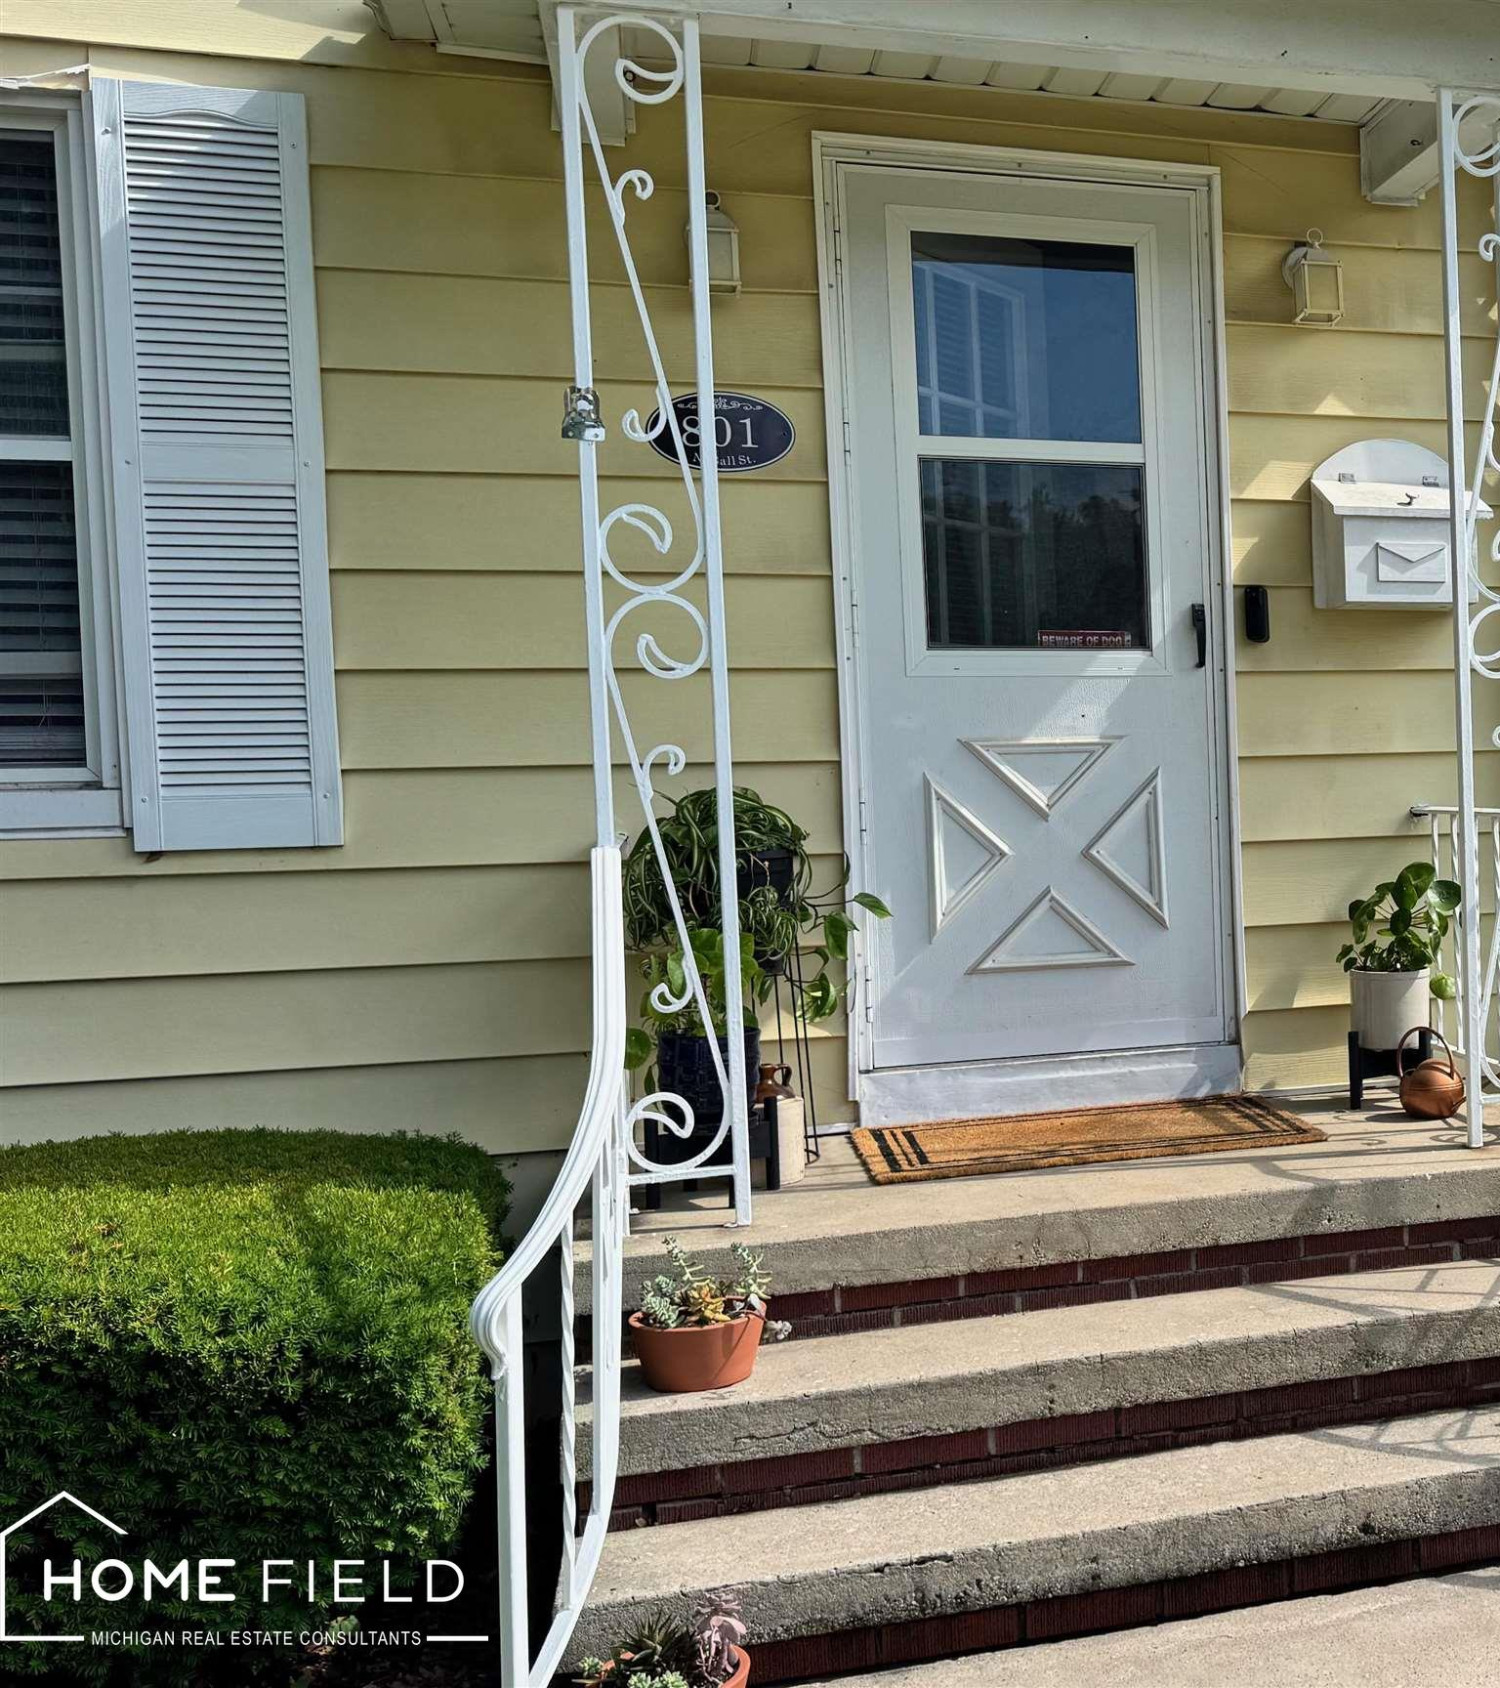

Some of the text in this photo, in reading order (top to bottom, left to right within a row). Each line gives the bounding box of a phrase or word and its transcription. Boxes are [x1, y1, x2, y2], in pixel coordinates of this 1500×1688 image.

[682, 415, 759, 448] 801
[738, 454, 757, 466] St.
[1042, 635, 1083, 647] BEWARE
[1086, 636, 1099, 647] OF
